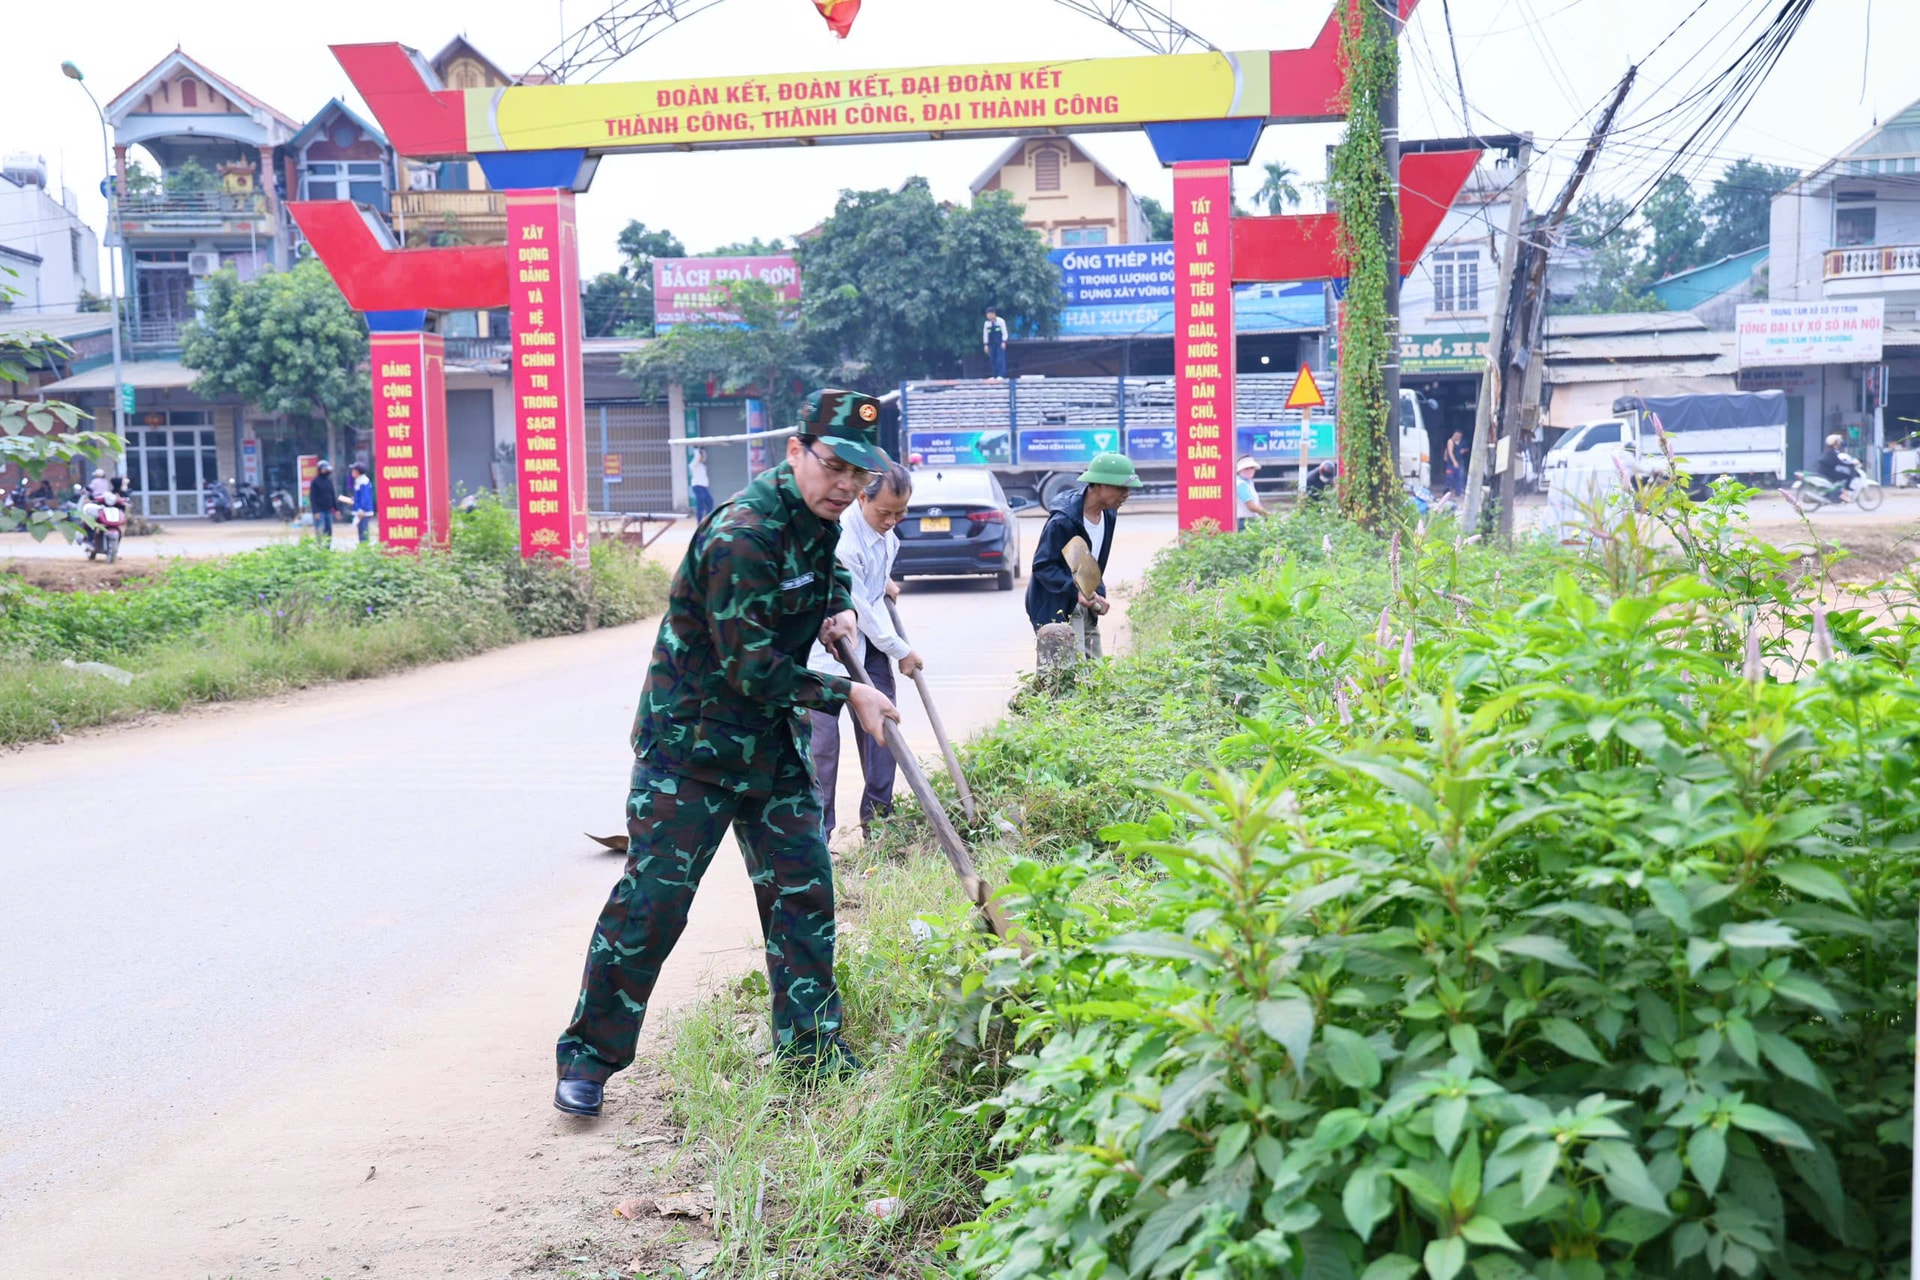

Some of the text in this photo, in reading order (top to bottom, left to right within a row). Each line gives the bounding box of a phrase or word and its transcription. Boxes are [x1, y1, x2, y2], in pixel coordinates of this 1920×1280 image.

[656, 65, 1063, 108] ĐOÀN KẾT, ĐOÀN KẾT, ĐẠI ĐOÀN KẾT
[604, 93, 1119, 137] THÀNH CÔNG, THÀNH CÔNG, ĐẠI THÀNH CÔNG
[1190, 195, 1211, 214] TẤT
[522, 224, 544, 240] XÂY
[1193, 216, 1209, 235] CẢ
[1195, 239, 1208, 255] VÌ
[518, 247, 549, 264] DỰNG
[1062, 248, 1175, 270] ỐNG THÉP HÒ
[519, 265, 550, 283] ĐẢNG
[661, 265, 711, 287] BÁCH
[759, 265, 796, 286] SƠN
[1079, 274, 1118, 286] TRỌNG
[1119, 271, 1157, 285] LƯỢNG
[1189, 262, 1215, 279] MỤC
[527, 288, 544, 304] VÀ
[1080, 288, 1112, 300] DỰNG
[1114, 286, 1136, 298] XÂY
[1138, 284, 1169, 296] VỮNG
[1190, 280, 1214, 297] TIÊU
[1190, 301, 1214, 317] DÂN
[529, 309, 544, 327] HỆ
[1861, 315, 1880, 331] NỘI
[519, 328, 556, 346] THỐNG
[1187, 321, 1218, 338] GIÀU,
[1187, 341, 1218, 358] NƯỚC
[1422, 338, 1443, 358] SỐ
[1452, 342, 1473, 358] XE
[521, 351, 556, 367] CHÍNH
[381, 360, 412, 377] ĐẢNG
[1185, 364, 1222, 380] MẠNH,
[530, 375, 548, 391] TRỊ
[1192, 383, 1215, 399] DÂN
[383, 382, 412, 401] CỘNG
[387, 401, 410, 418] SẢN
[522, 396, 558, 409] TRONG
[387, 423, 411, 441] VIỆT
[526, 416, 556, 432] SẠCH
[1189, 423, 1220, 439] CÔNG
[527, 435, 556, 451] VỮNG
[1161, 431, 1176, 449] 3
[1269, 439, 1318, 451] KAZIC
[387, 445, 413, 459] NAM
[383, 466, 419, 480] QUANG
[524, 458, 561, 474] MẠNH,
[1193, 464, 1216, 480] VĂN
[388, 486, 415, 499] VINH
[529, 477, 557, 493] TOÀN
[1188, 485, 1221, 500] MINH!
[386, 504, 419, 519] MUÔN
[529, 498, 558, 516] DIỆN!
[388, 525, 418, 539] NĂM!
